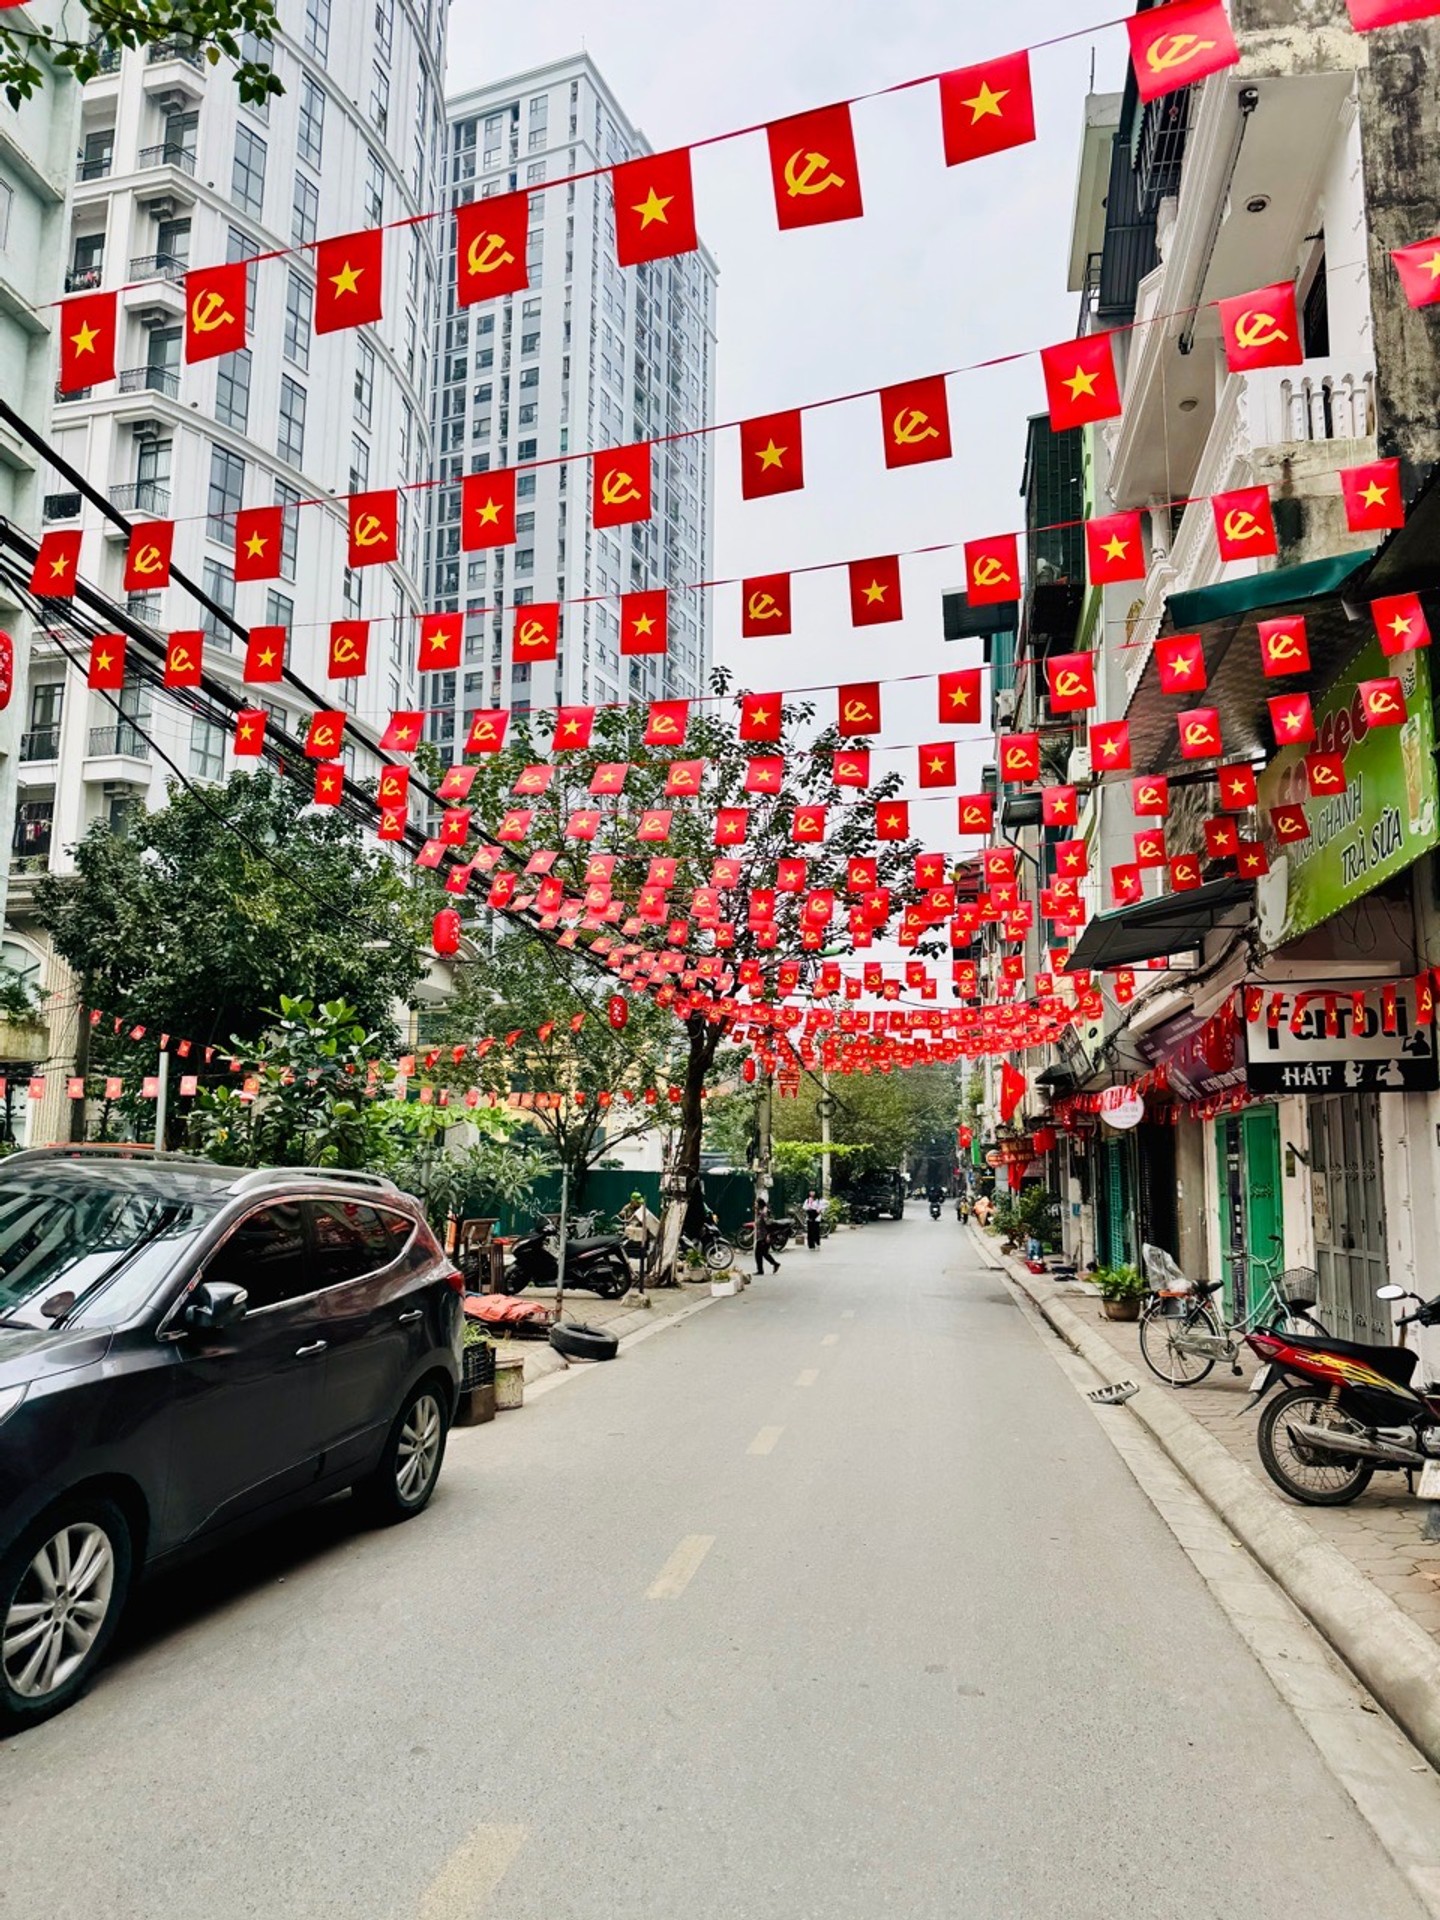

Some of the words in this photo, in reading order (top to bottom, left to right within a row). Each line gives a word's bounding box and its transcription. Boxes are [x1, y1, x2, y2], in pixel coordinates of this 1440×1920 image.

[1318, 769, 1363, 849] CHANH
[1341, 827, 1367, 887] TRÀ
[1371, 804, 1403, 868] SỮA
[1281, 1062, 1332, 1087] HÁT
